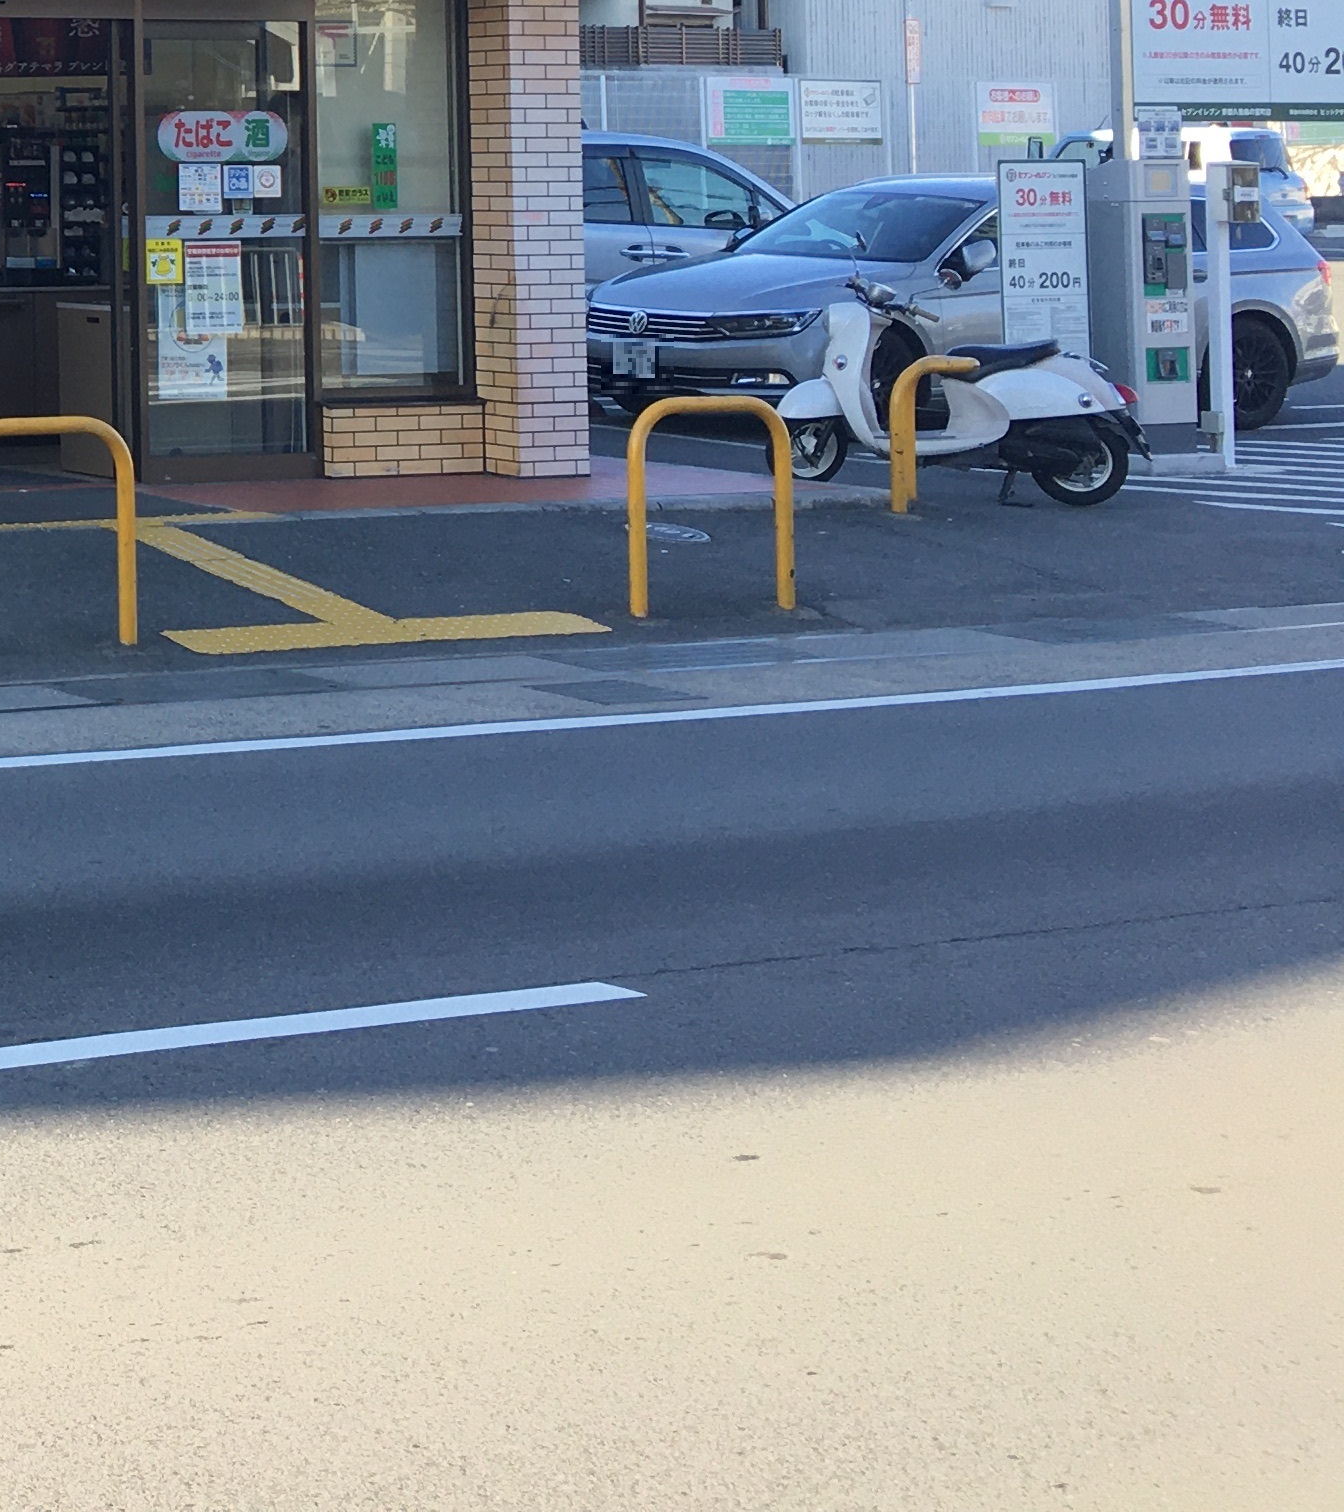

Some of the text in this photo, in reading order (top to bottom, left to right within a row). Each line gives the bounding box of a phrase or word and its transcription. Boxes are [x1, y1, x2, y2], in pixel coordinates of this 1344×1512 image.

[1277, 7, 1308, 28] 終日
[173, 117, 270, 149] たばこ 酒
